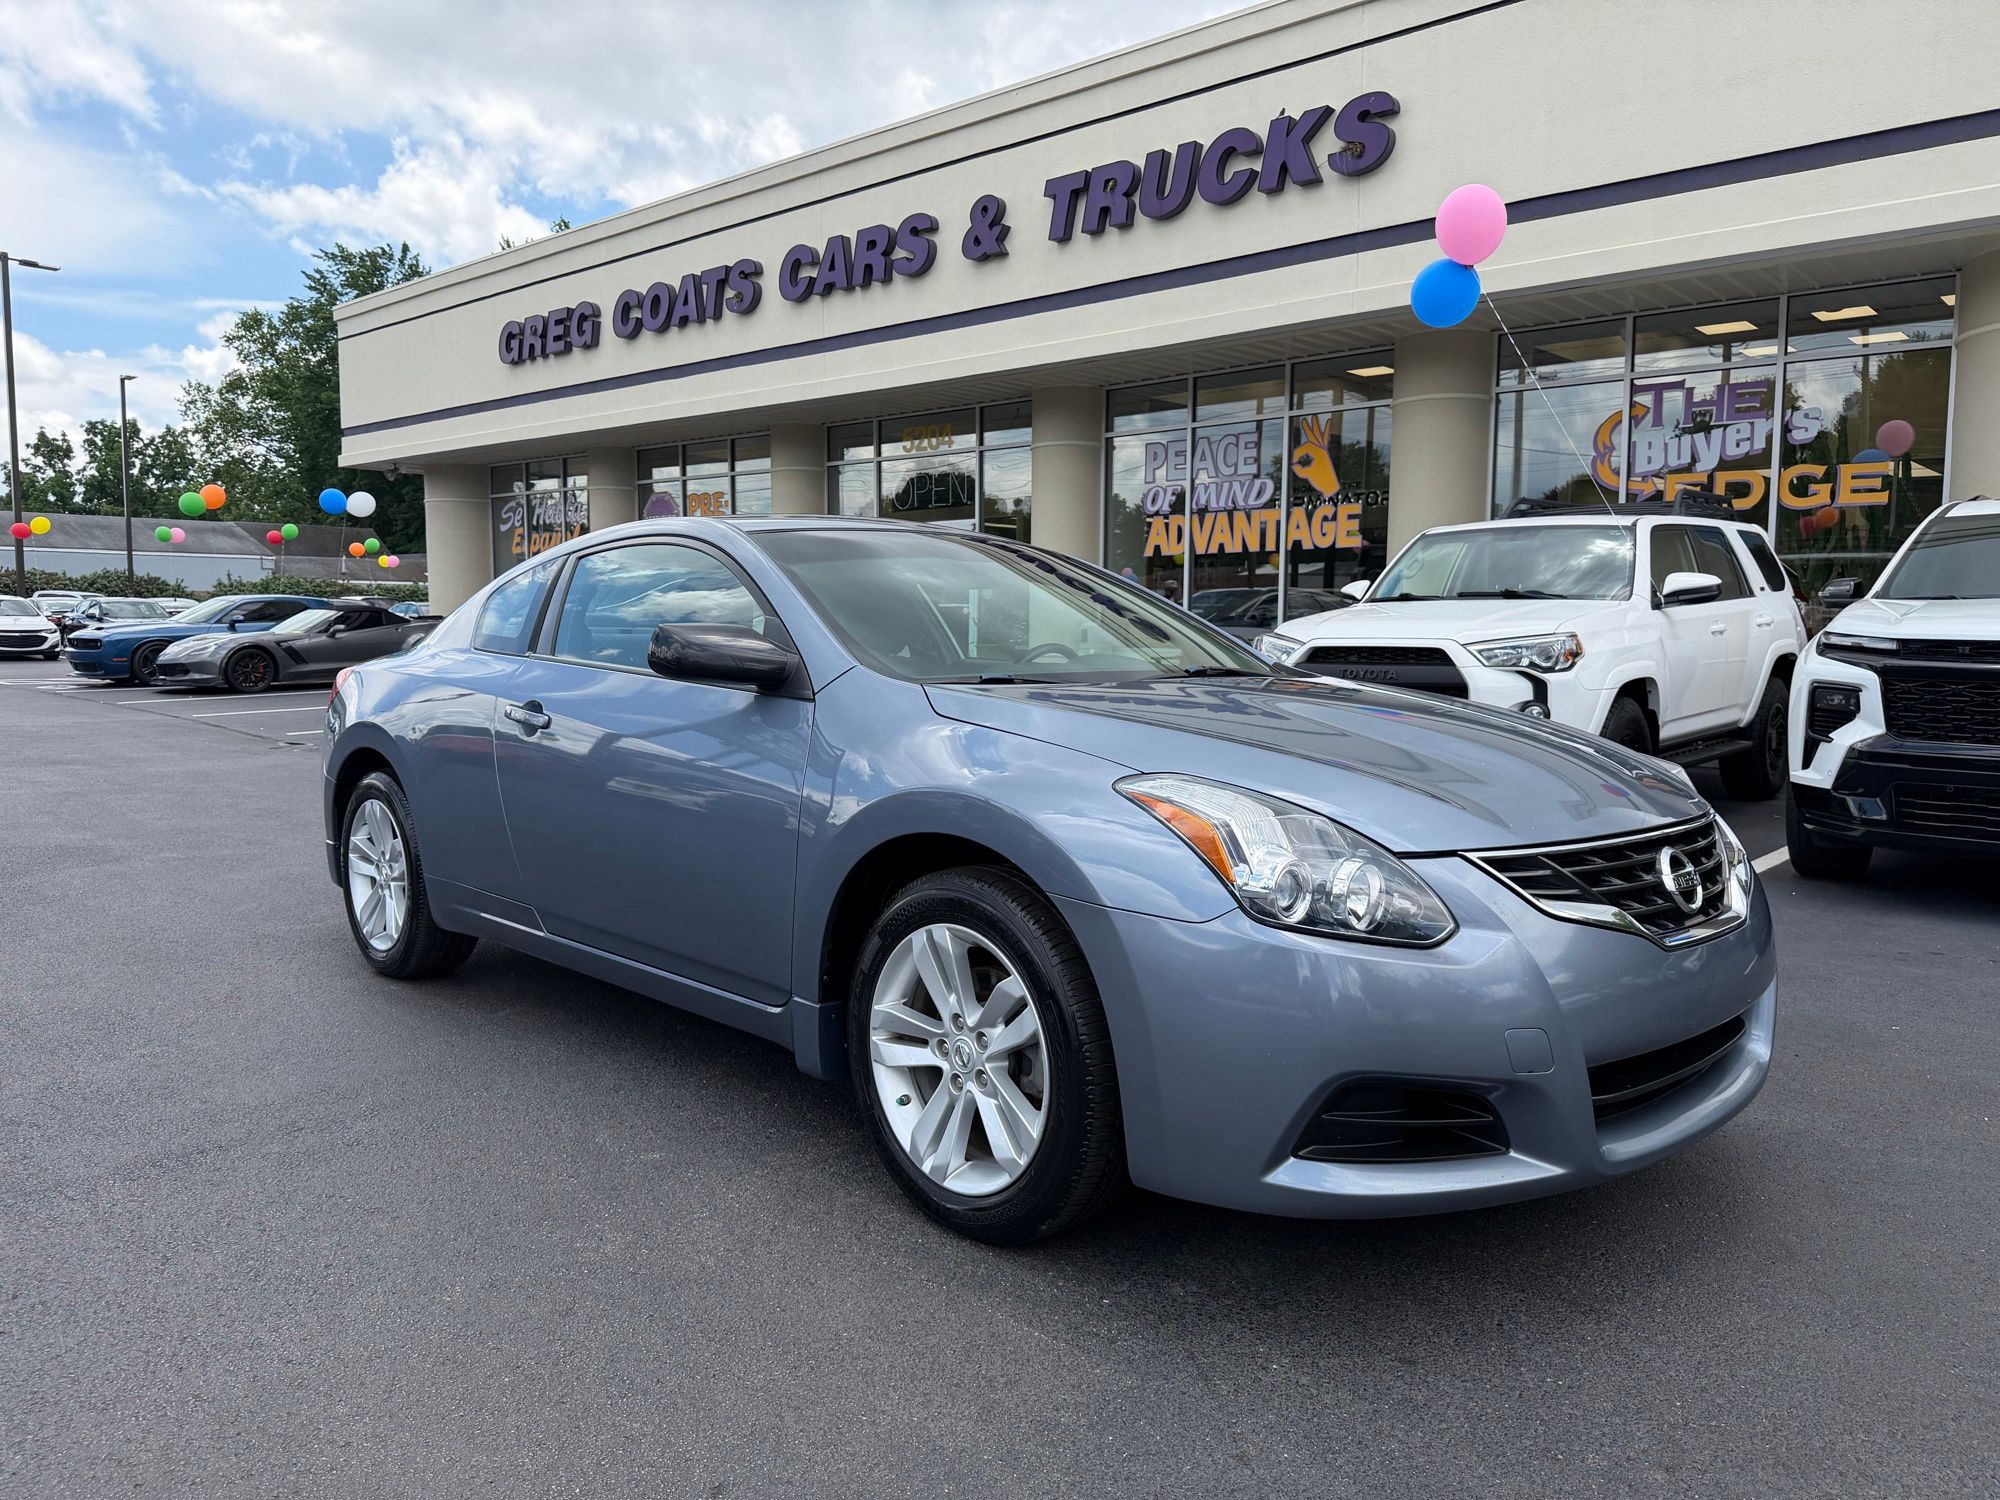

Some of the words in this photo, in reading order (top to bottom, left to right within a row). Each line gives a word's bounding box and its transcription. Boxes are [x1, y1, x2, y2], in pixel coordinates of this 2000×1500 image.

[499, 301, 601, 364] GREG
[613, 258, 763, 340] COATS
[779, 212, 939, 301] CARS
[962, 193, 1010, 262] &
[1043, 91, 1400, 243] TRUCKS
[1632, 378, 1768, 428] THE
[902, 423, 954, 453] 5204
[1144, 431, 1261, 484] PEACE
[1631, 405, 1822, 478] Buyer's
[894, 472, 971, 510] OPEN
[1144, 485, 1184, 515] OF
[1191, 477, 1275, 512] MIND
[499, 501, 523, 532] Se
[1143, 503, 1362, 557] ADVANTAGE
[1339, 668, 1398, 681] TOYOTA
